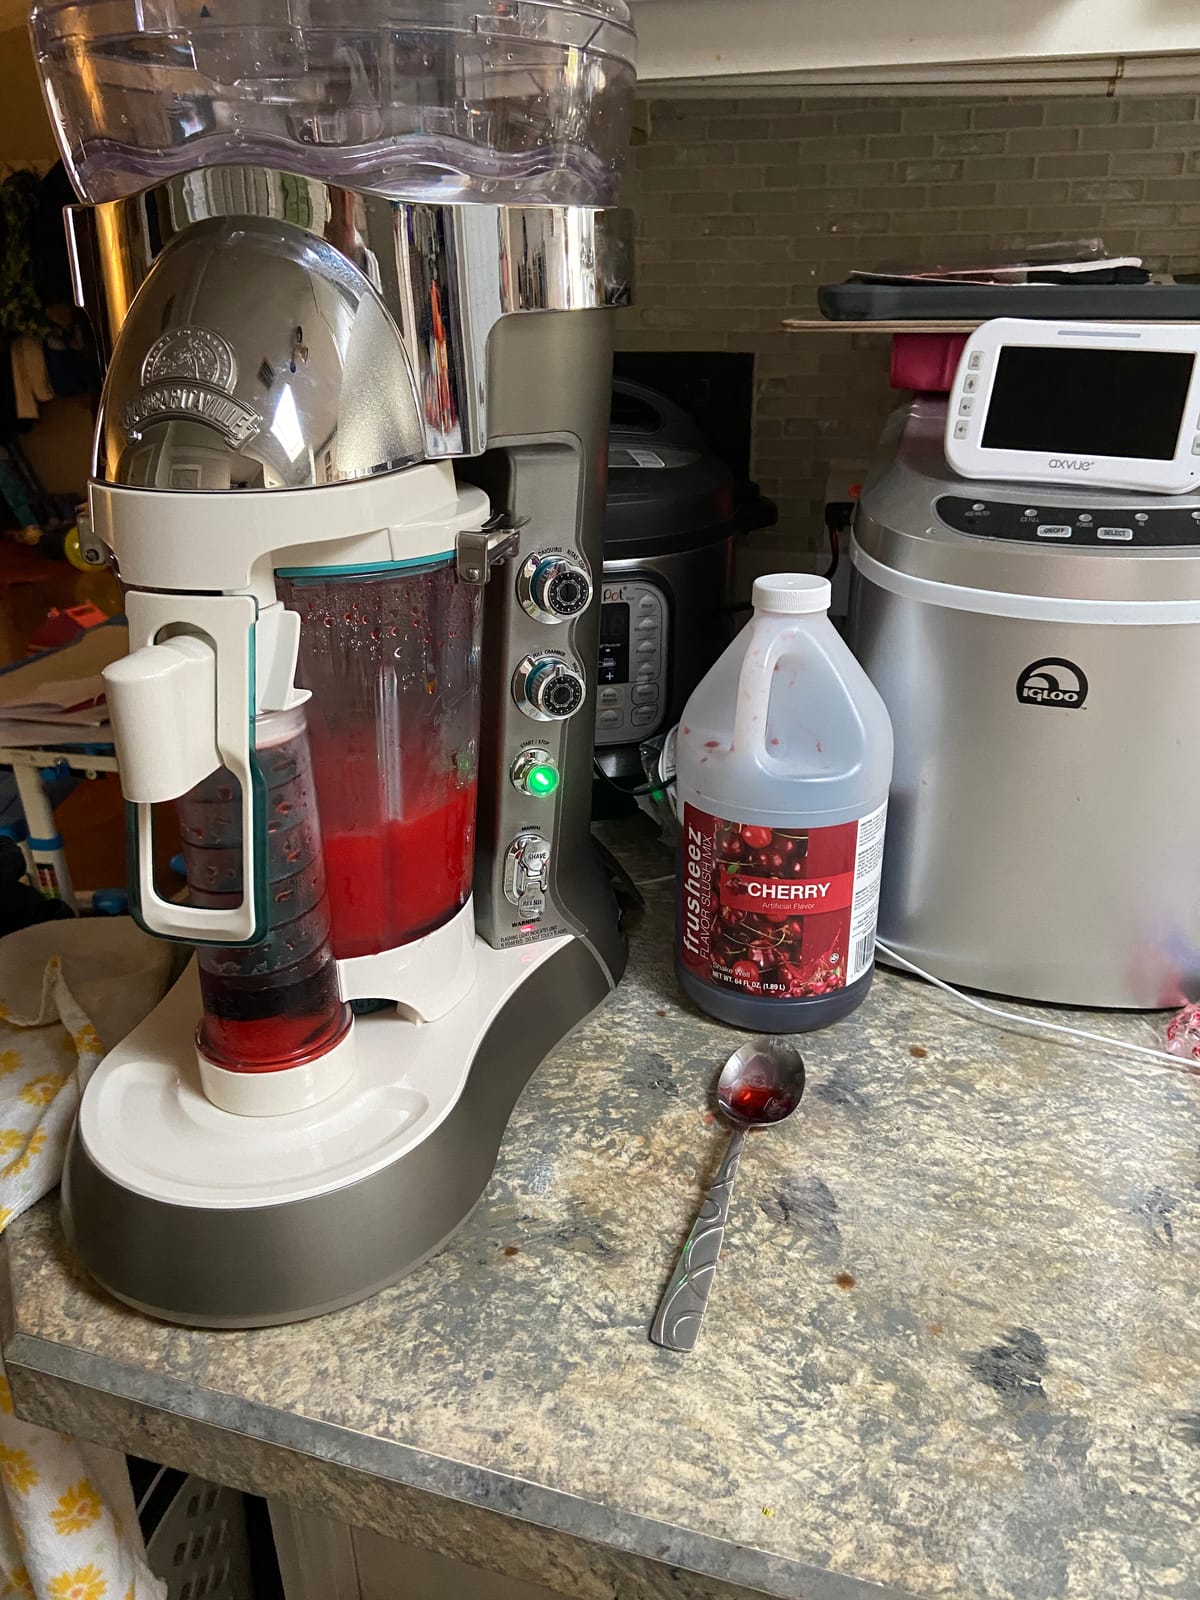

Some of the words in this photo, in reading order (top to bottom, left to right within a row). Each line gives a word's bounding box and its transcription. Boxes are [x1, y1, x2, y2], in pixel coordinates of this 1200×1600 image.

[1049, 459, 1091, 471] axvue
[1104, 529, 1126, 537] SELECT
[603, 589, 625, 602] Pot
[520, 740, 534, 748] START
[702, 834, 713, 860] MIX
[528, 852, 547, 860] SHAVE
[683, 825, 702, 955] frusheez
[701, 861, 712, 907] SLUSH
[747, 882, 831, 899] CHERRY
[762, 902, 792, 910] Artificial
[700, 909, 711, 960] FLAVOR
[712, 961, 733, 973] Shake
[735, 966, 751, 978] Well
[723, 975, 734, 983] WT.
